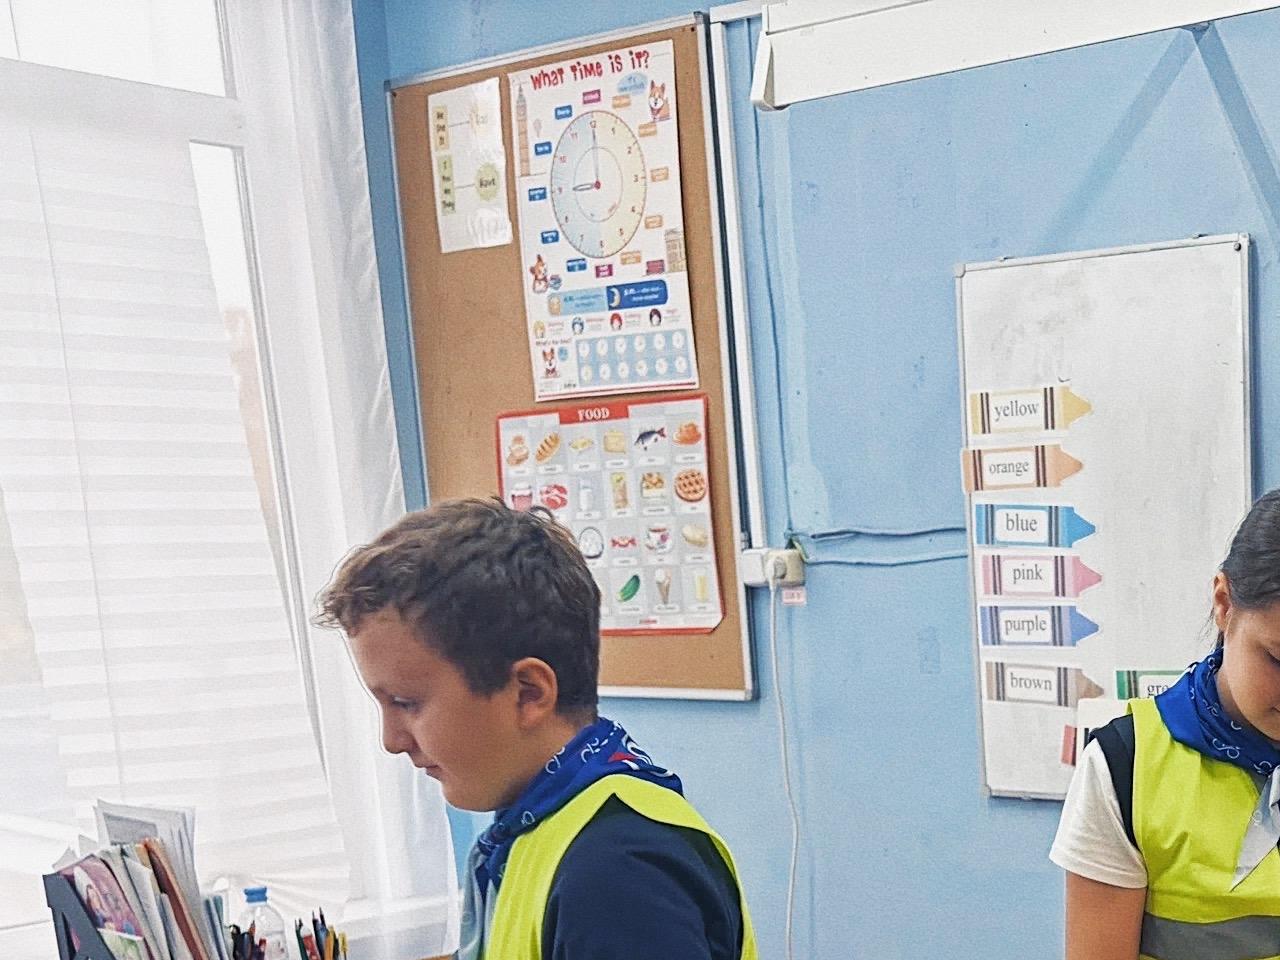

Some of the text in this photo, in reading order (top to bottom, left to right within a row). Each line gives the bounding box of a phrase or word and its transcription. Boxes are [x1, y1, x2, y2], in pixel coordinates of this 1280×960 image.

[578, 407, 609, 421] FOOD
[994, 401, 1039, 422] yellow
[989, 460, 1029, 476] orange
[1006, 513, 1037, 531] blue
[1013, 563, 1043, 584] pink
[1005, 615, 1047, 635] purple
[1010, 672, 1052, 691] brown
